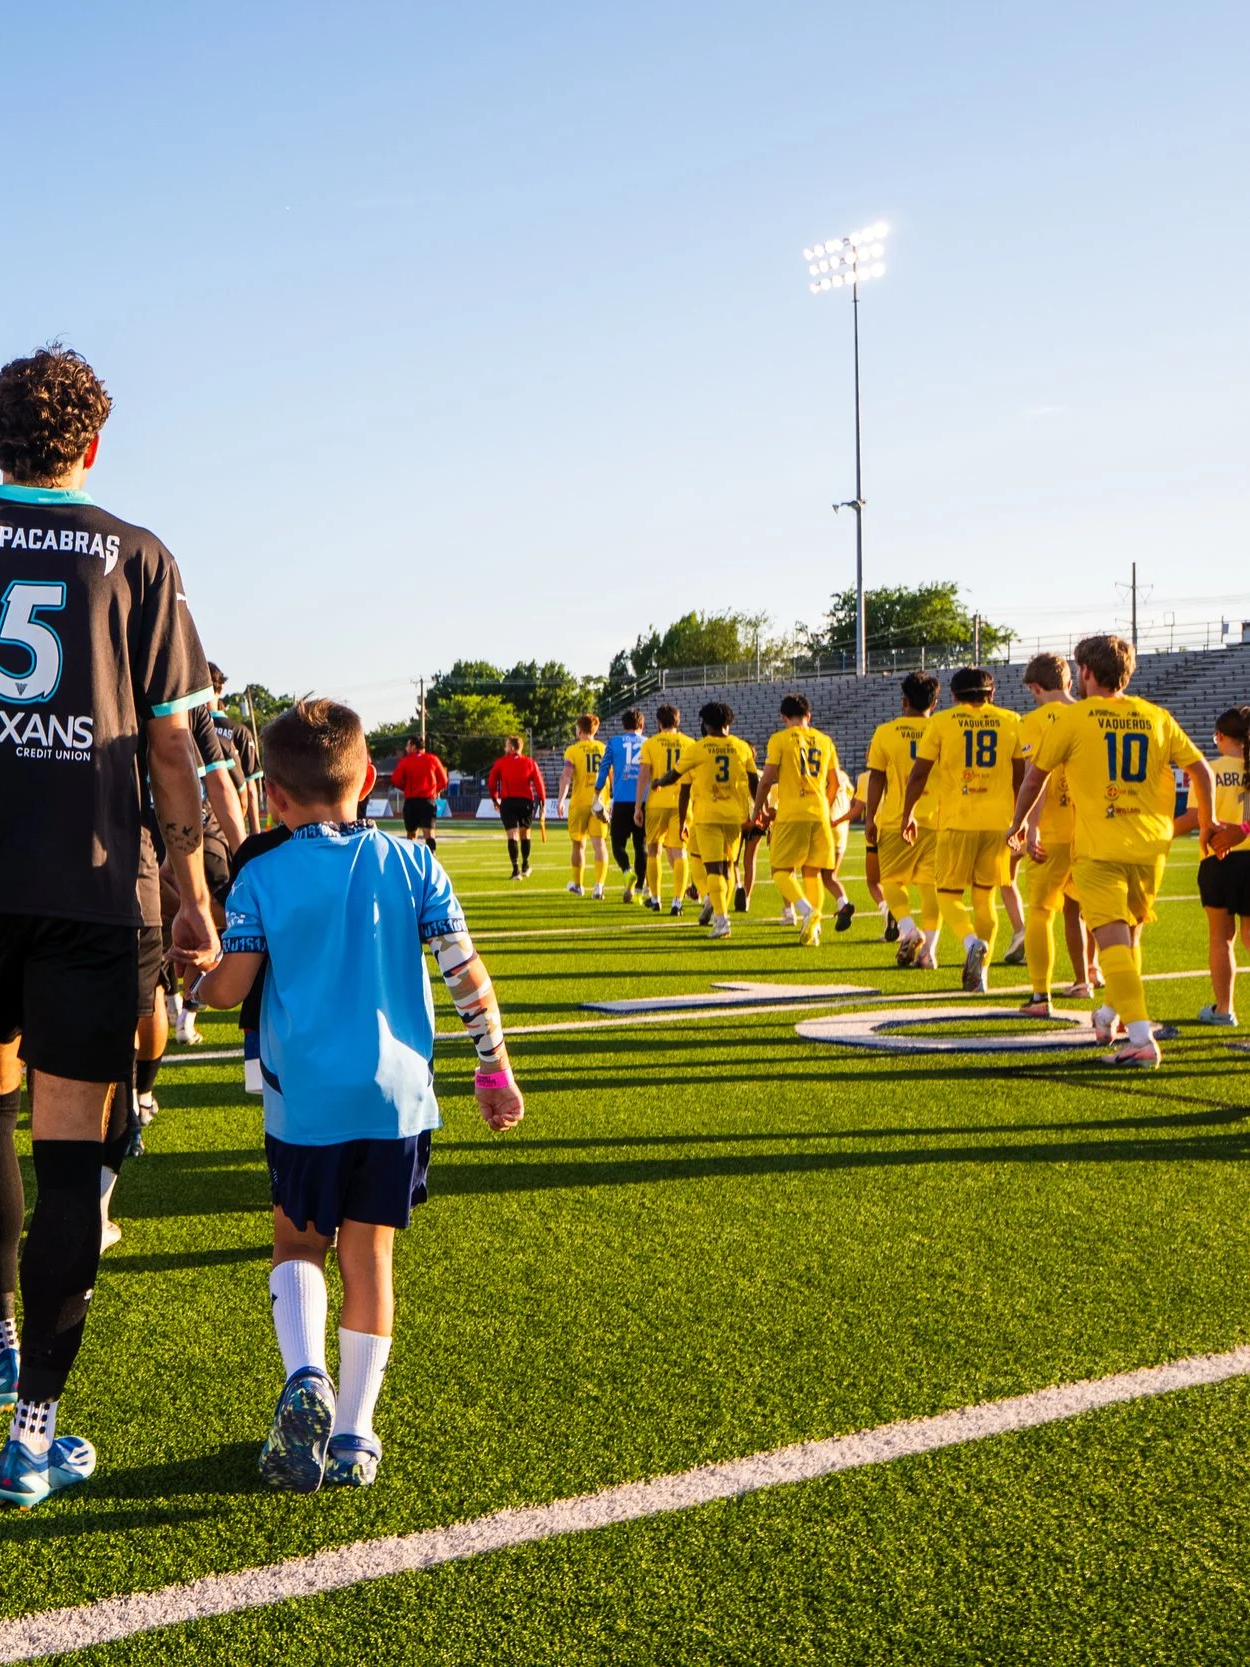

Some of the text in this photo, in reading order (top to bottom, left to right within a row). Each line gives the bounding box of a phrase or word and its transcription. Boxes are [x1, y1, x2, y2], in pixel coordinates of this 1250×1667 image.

[957, 719, 1001, 728] VAQUEROS
[1097, 718, 1152, 730] VAQUEROS
[15, 747, 91, 762] CREDIT UNION
[622, 742, 642, 765] 12
[962, 729, 998, 768] 18
[1103, 731, 1149, 783] 10
[714, 755, 730, 783] 3
[799, 747, 822, 777] 15
